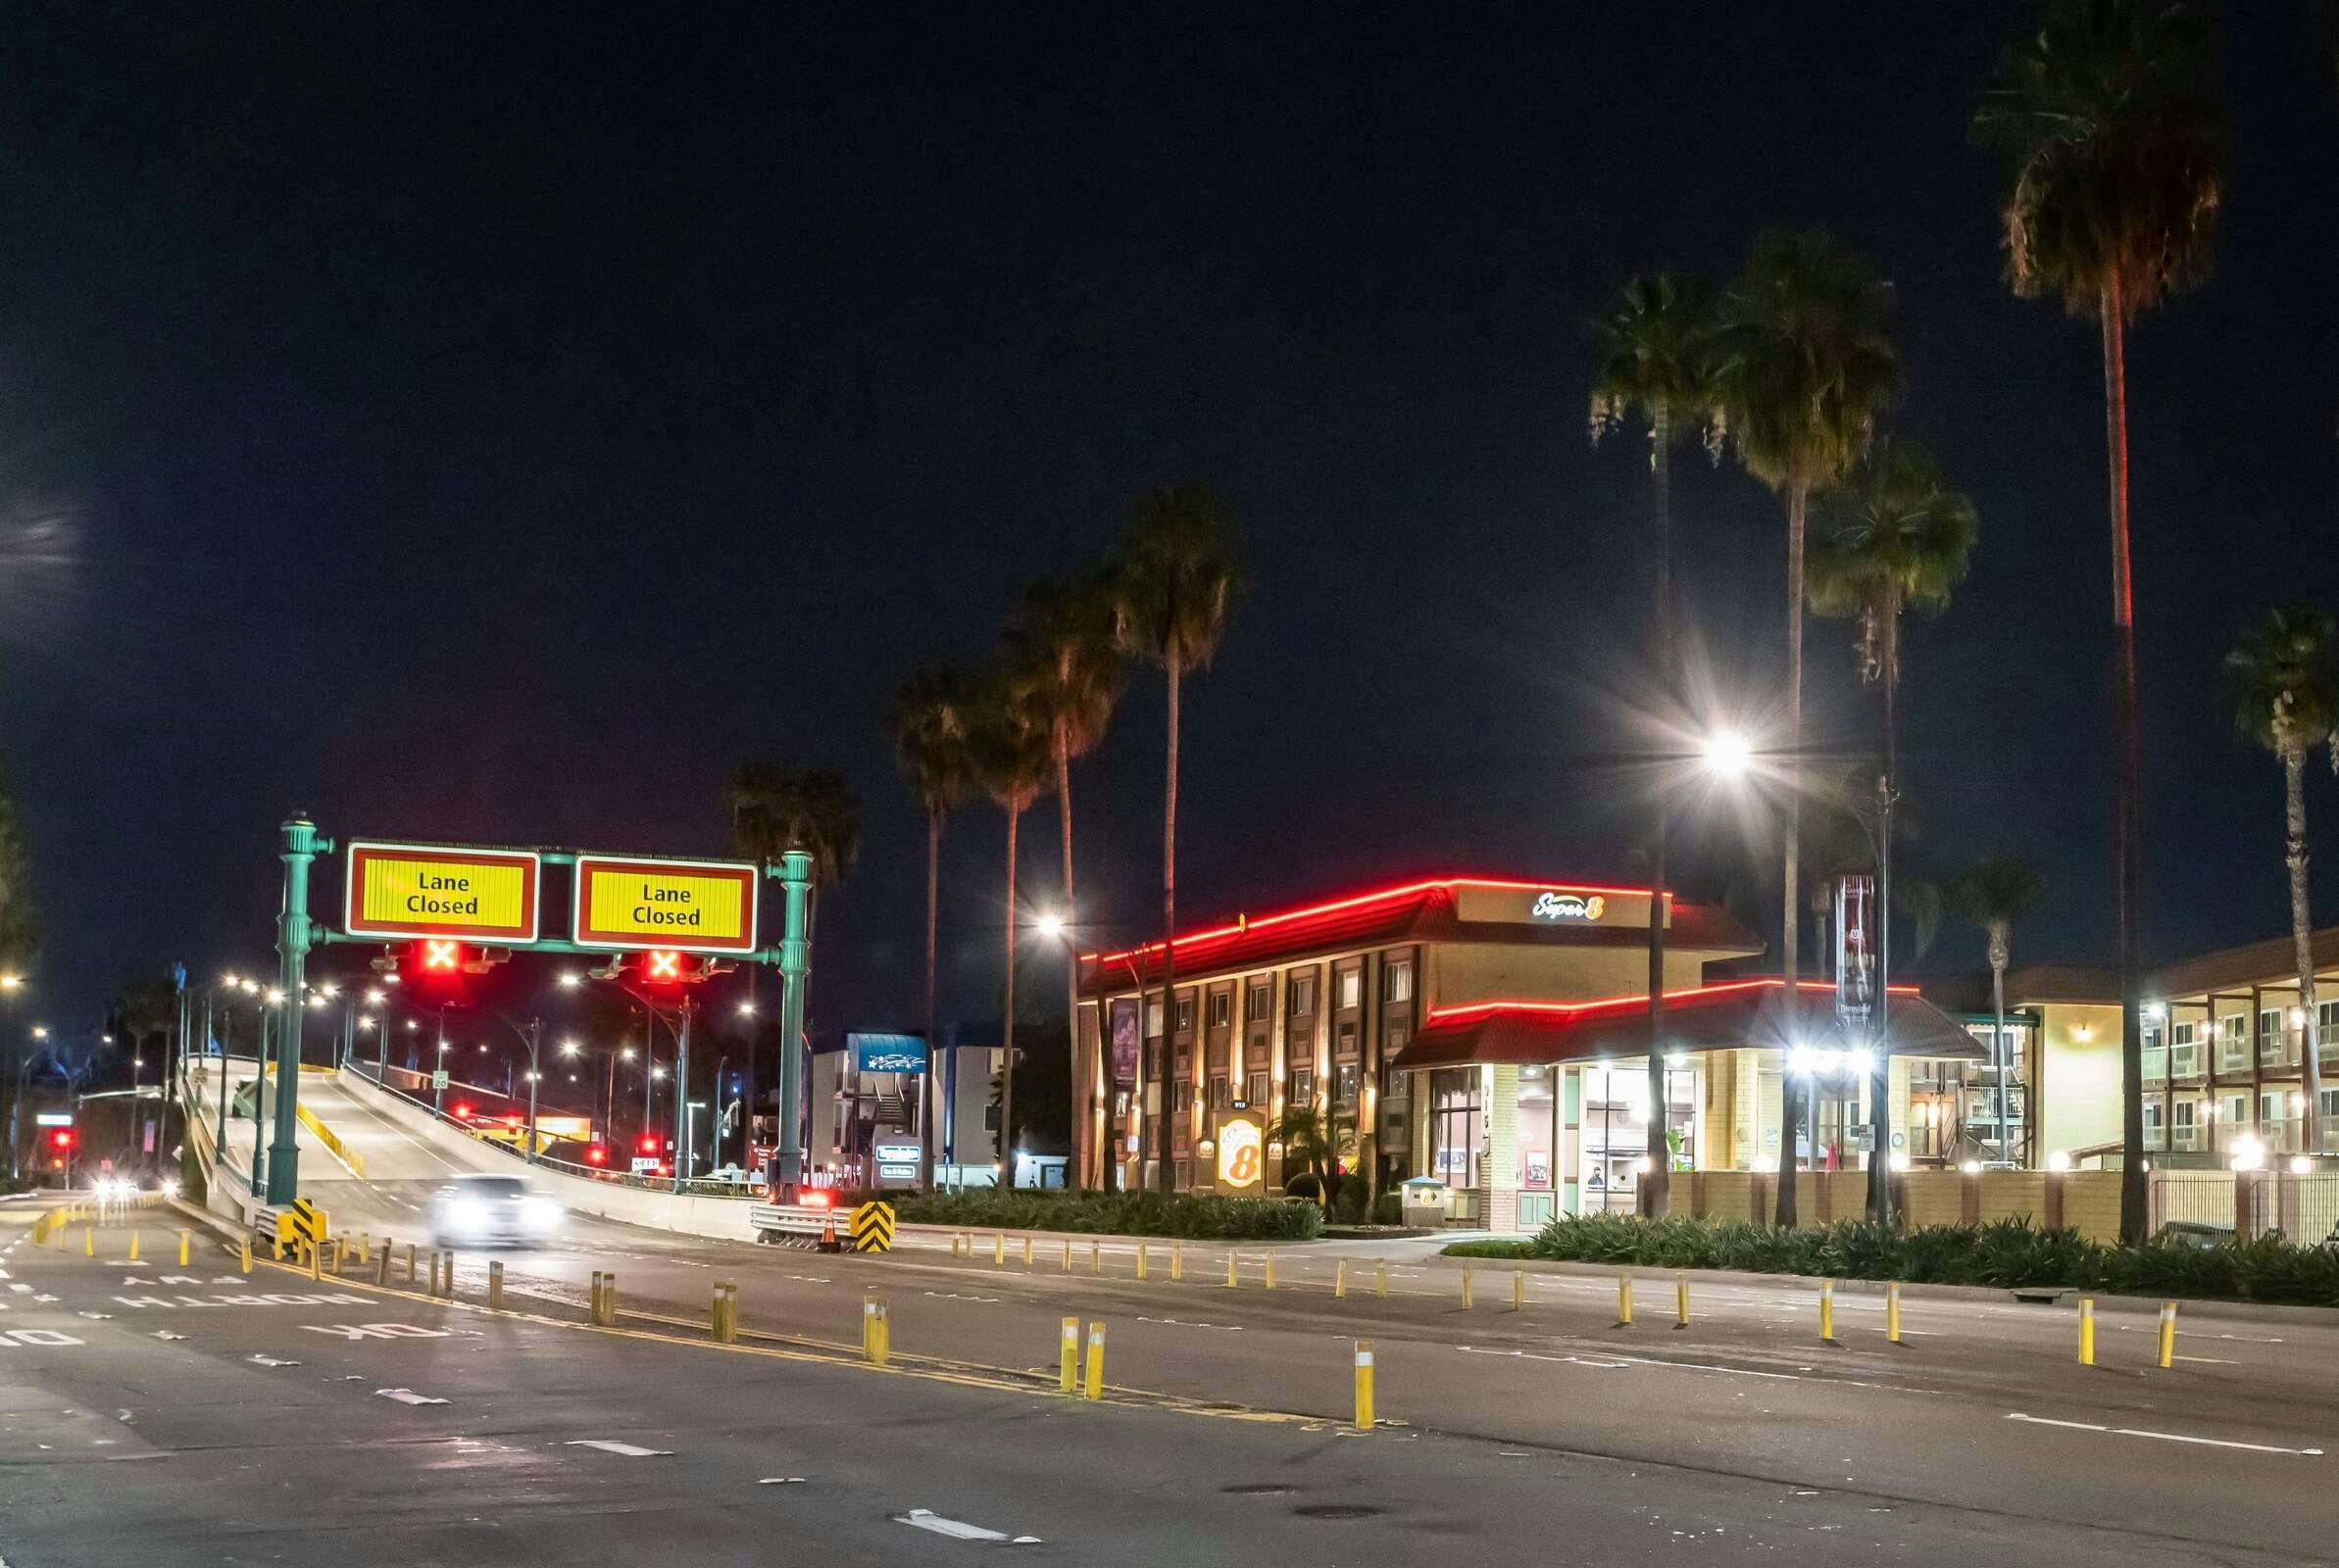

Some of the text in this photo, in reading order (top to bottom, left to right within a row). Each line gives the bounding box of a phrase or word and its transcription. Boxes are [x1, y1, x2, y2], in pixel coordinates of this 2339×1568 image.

[419, 872, 470, 892] Lane
[643, 884, 691, 904] Lane
[407, 895, 478, 914] Closed
[1533, 893, 1605, 919] Super 8
[633, 906, 700, 926] Closed
[1229, 1145, 1260, 1180] 8
[110, 1294, 379, 1308] NORTH
